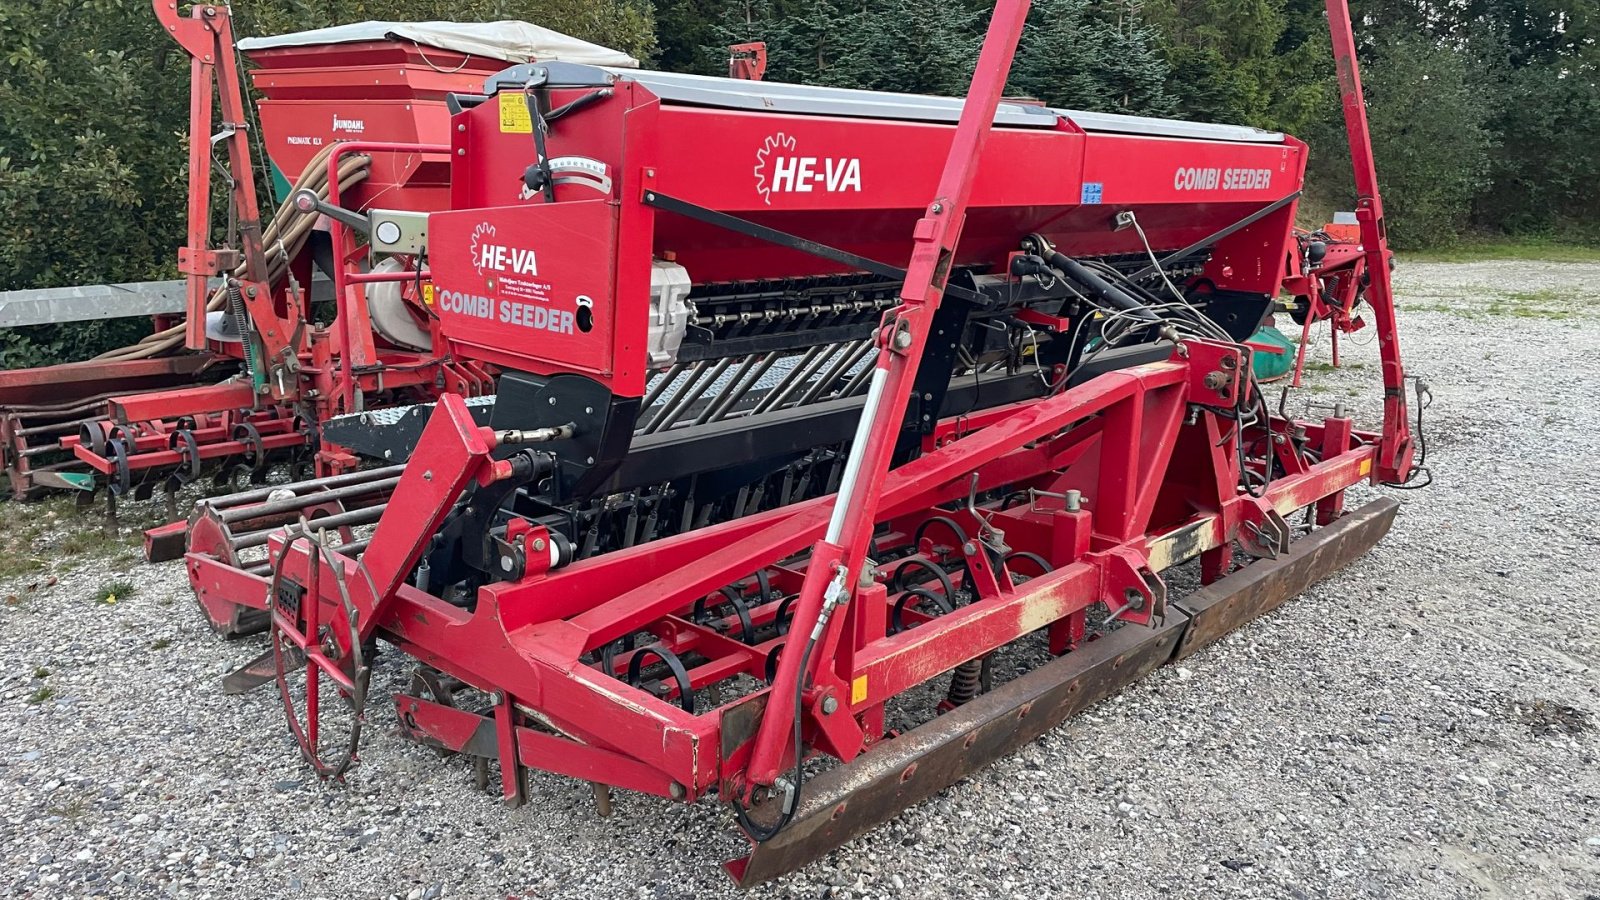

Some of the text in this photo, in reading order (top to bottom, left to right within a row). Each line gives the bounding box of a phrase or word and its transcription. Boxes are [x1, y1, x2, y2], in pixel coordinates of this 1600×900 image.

[771, 156, 862, 192] HE-VA
[1174, 167, 1272, 191] COMBI SEEDER
[481, 244, 538, 276] HE-VA
[440, 289, 574, 335] COMBI SEEDER
